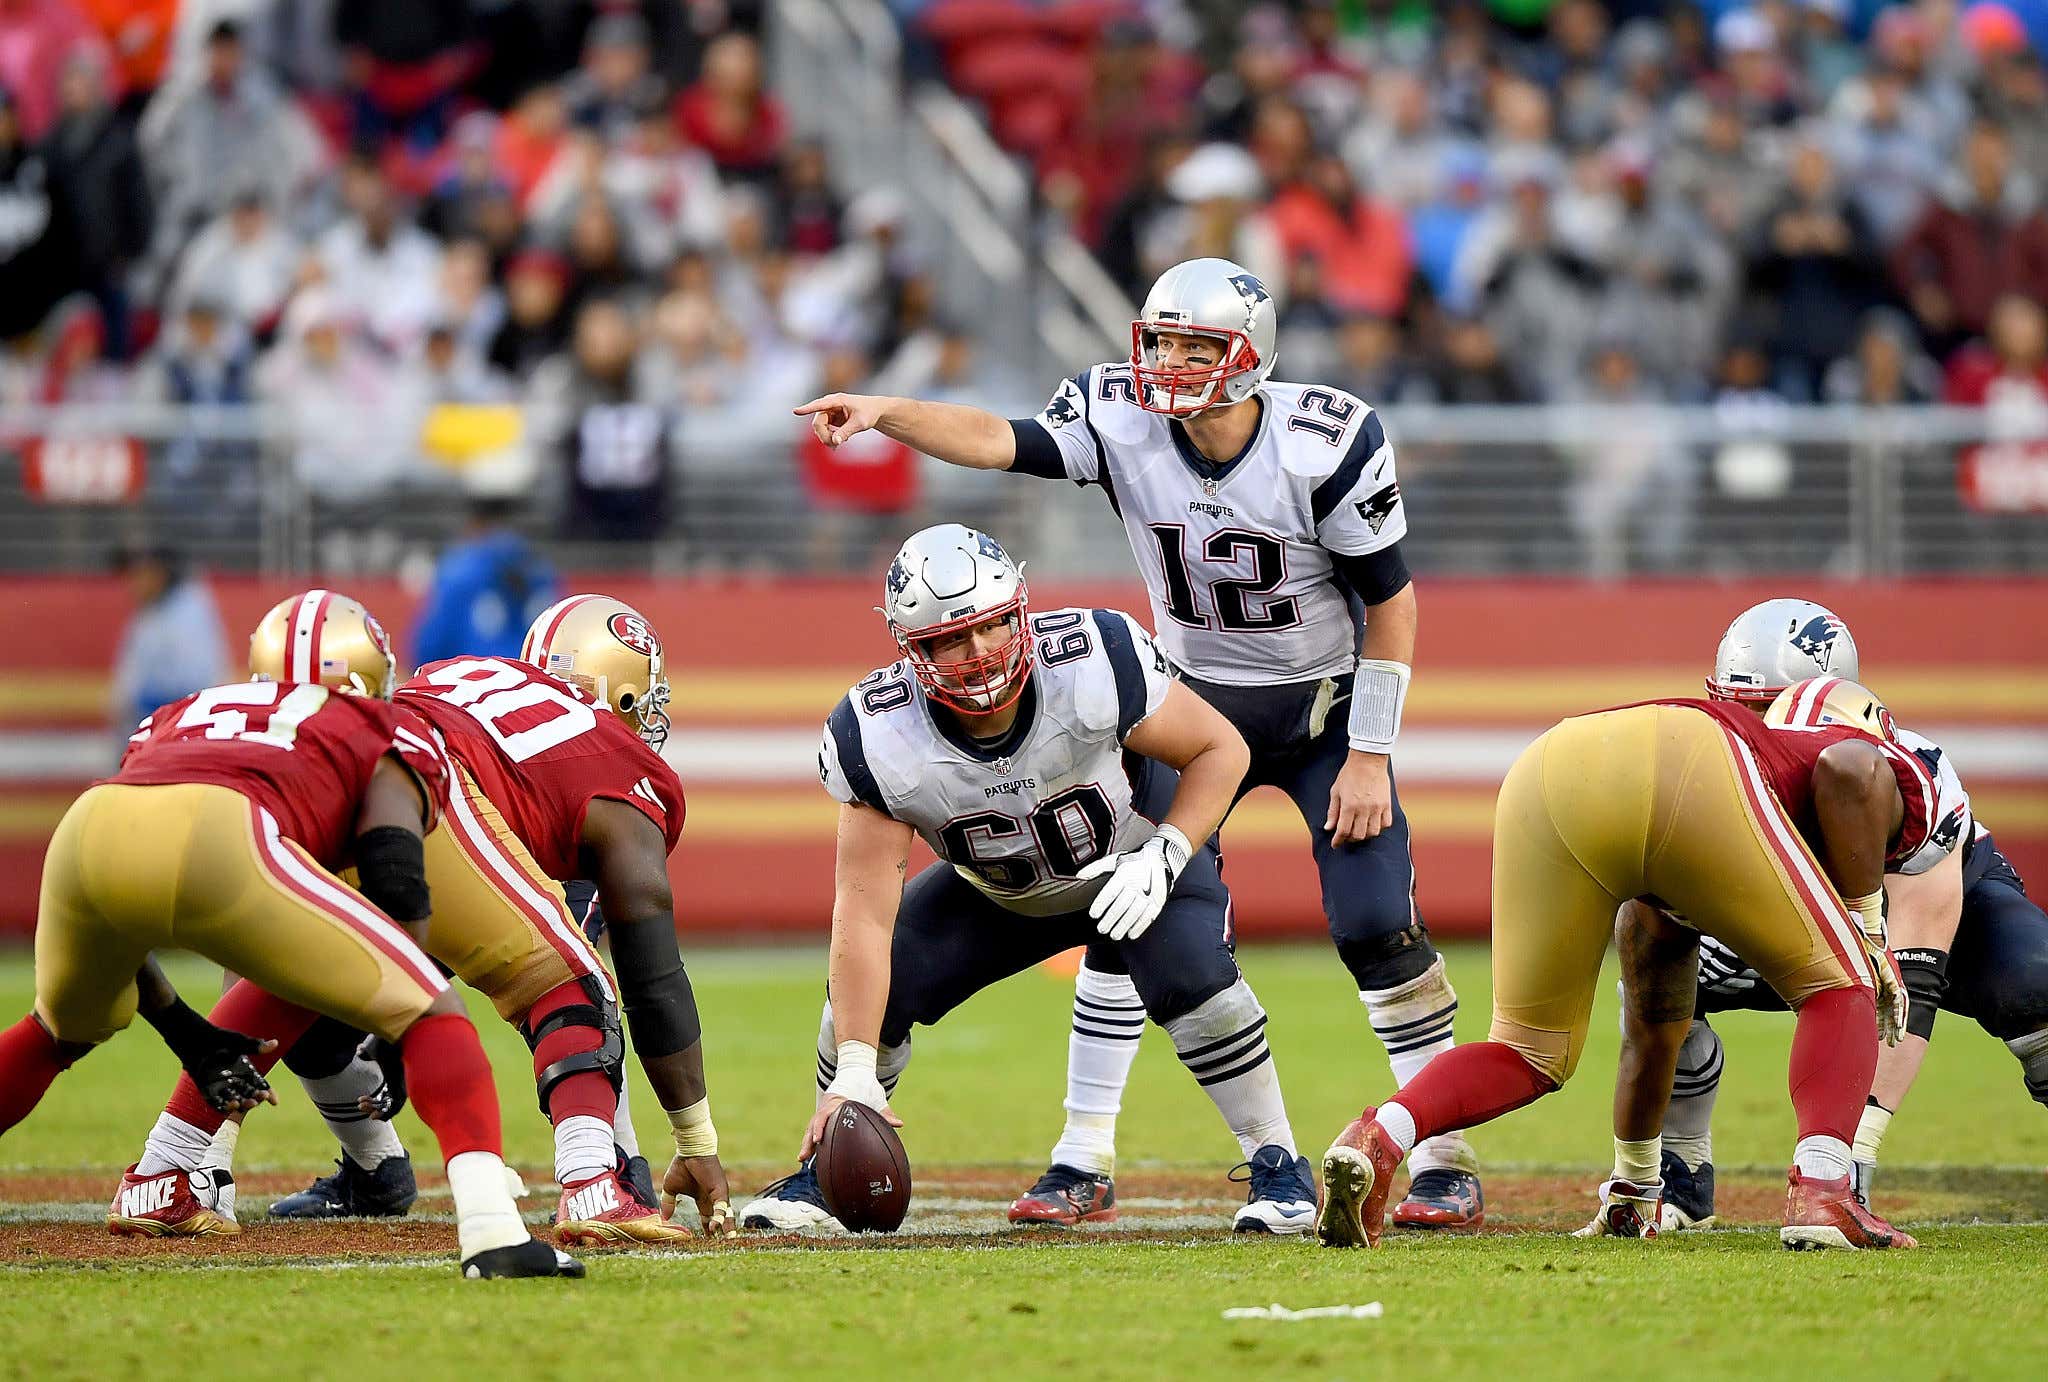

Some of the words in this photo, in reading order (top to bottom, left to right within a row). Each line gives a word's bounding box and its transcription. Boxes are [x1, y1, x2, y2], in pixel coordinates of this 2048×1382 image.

[1098, 364, 1155, 407] 12
[1287, 388, 1359, 447] 12
[1189, 502, 1234, 517] PATRIOTS
[1146, 522, 1303, 633] 12
[1031, 612, 1093, 669] 60
[427, 658, 597, 763] 90
[984, 778, 1036, 798] PATRIOTS
[935, 782, 1117, 892] 60
[121, 1175, 178, 1218] NIKE
[567, 1178, 620, 1222] NIKE
